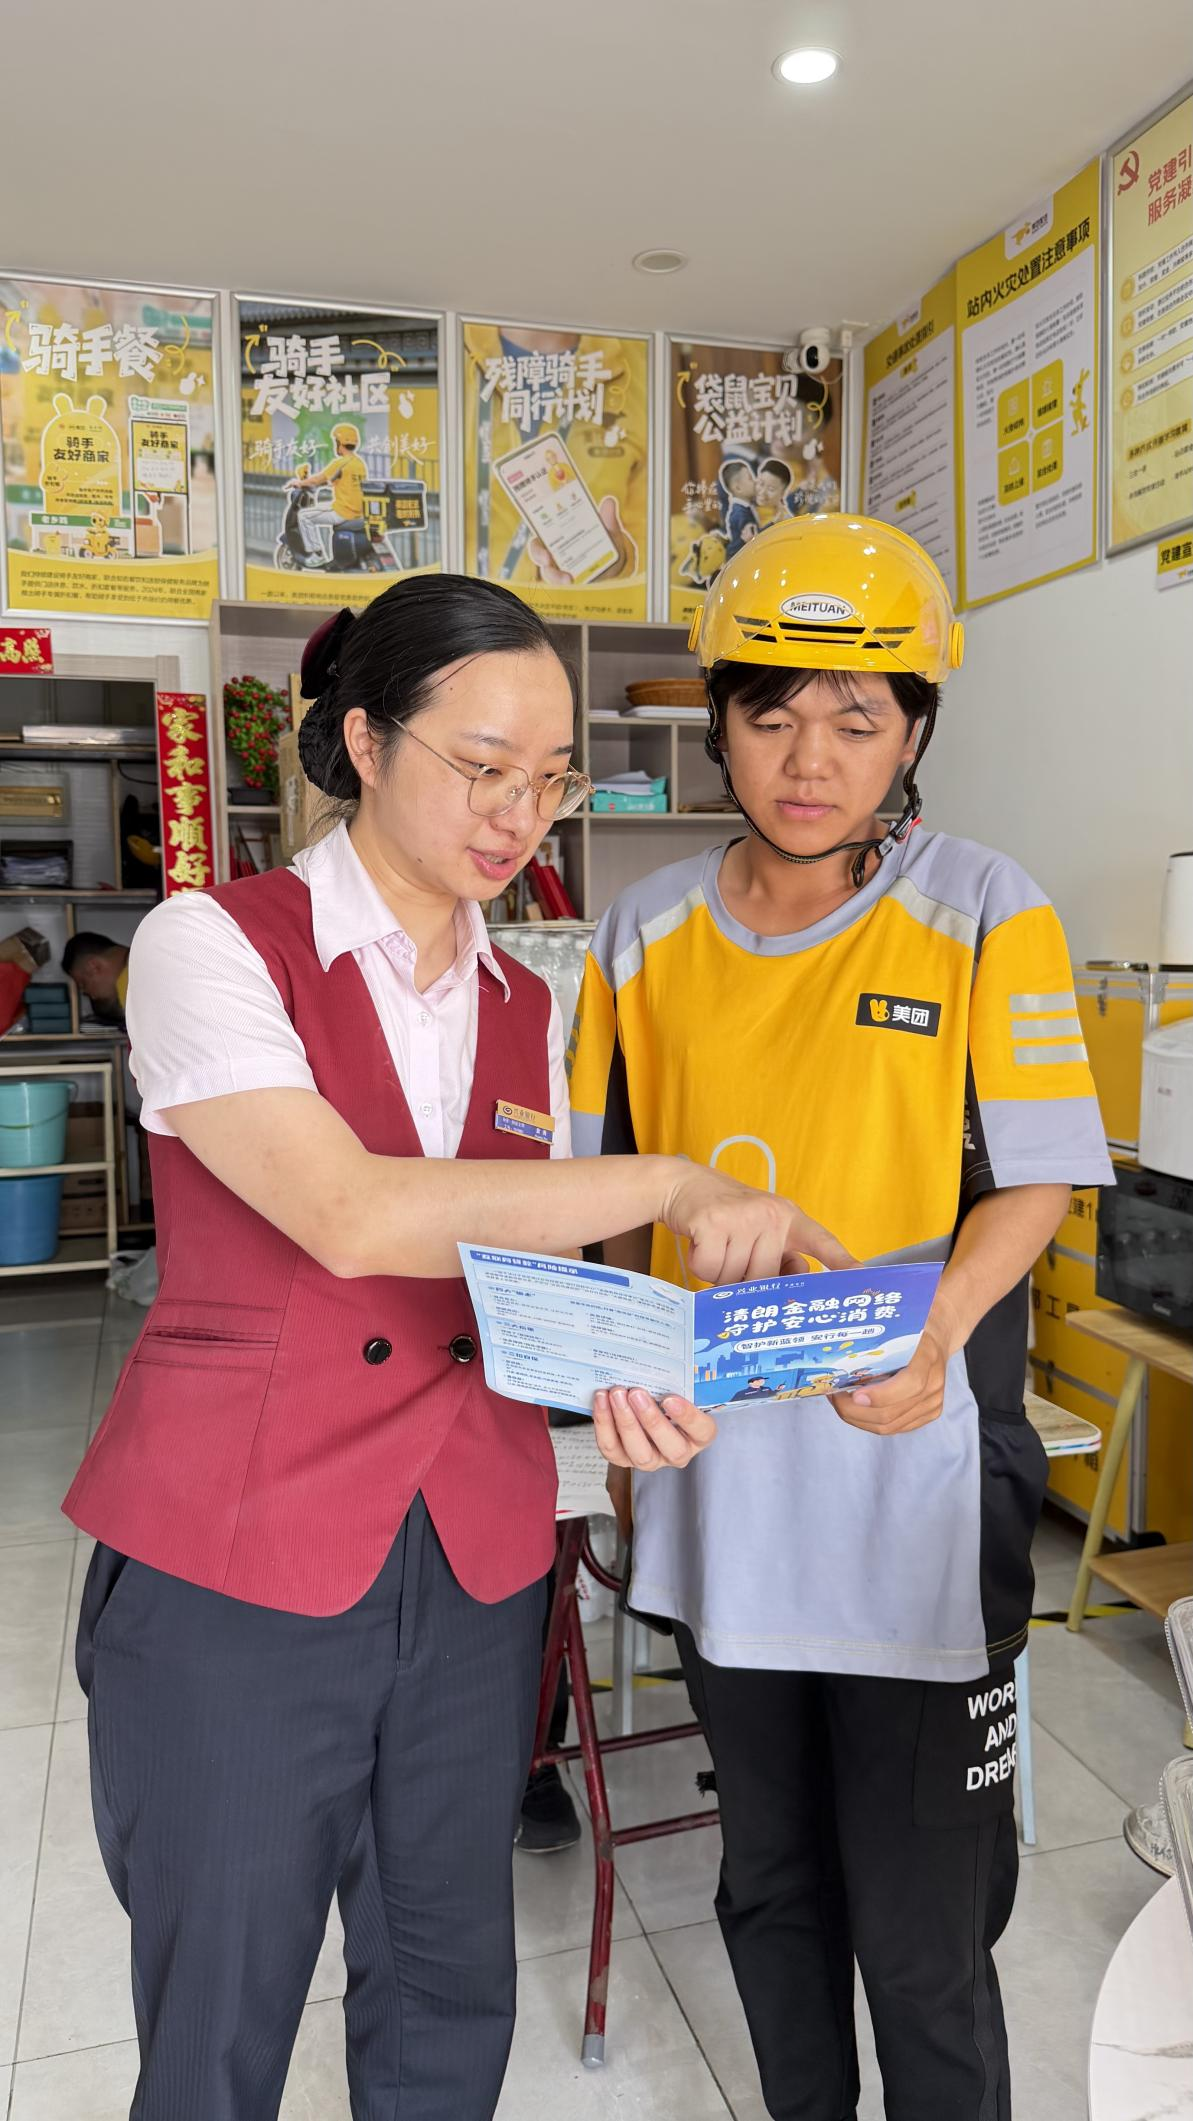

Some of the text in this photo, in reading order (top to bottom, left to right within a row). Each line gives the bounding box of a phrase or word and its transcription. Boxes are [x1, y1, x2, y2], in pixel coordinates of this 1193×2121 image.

[1147, 143, 1193, 198] 党建引
[966, 216, 1091, 319] 站内火灾处置注意事项
[22, 322, 164, 383] 骑手餐
[261, 334, 345, 378] 骑手
[480, 349, 612, 401] 残障骑手
[694, 372, 798, 413] 袋鼠宝贝
[250, 371, 391, 419] 友好社区
[502, 382, 604, 433] 同行计划
[66, 436, 94, 449] 骑手
[141, 438, 179, 449] 友好商家
[149, 430, 168, 440] 骑手
[693, 409, 802, 446] 公益计划
[53, 448, 110, 463] 友好商家
[790, 601, 846, 615] MEITUAN
[892, 1004, 930, 1027] 美团
[722, 1291, 902, 1325] 清朗金融网络
[725, 1305, 899, 1337] 守护安心消费
[967, 1681, 1017, 1720] WOR
[984, 1712, 1018, 1752] AND
